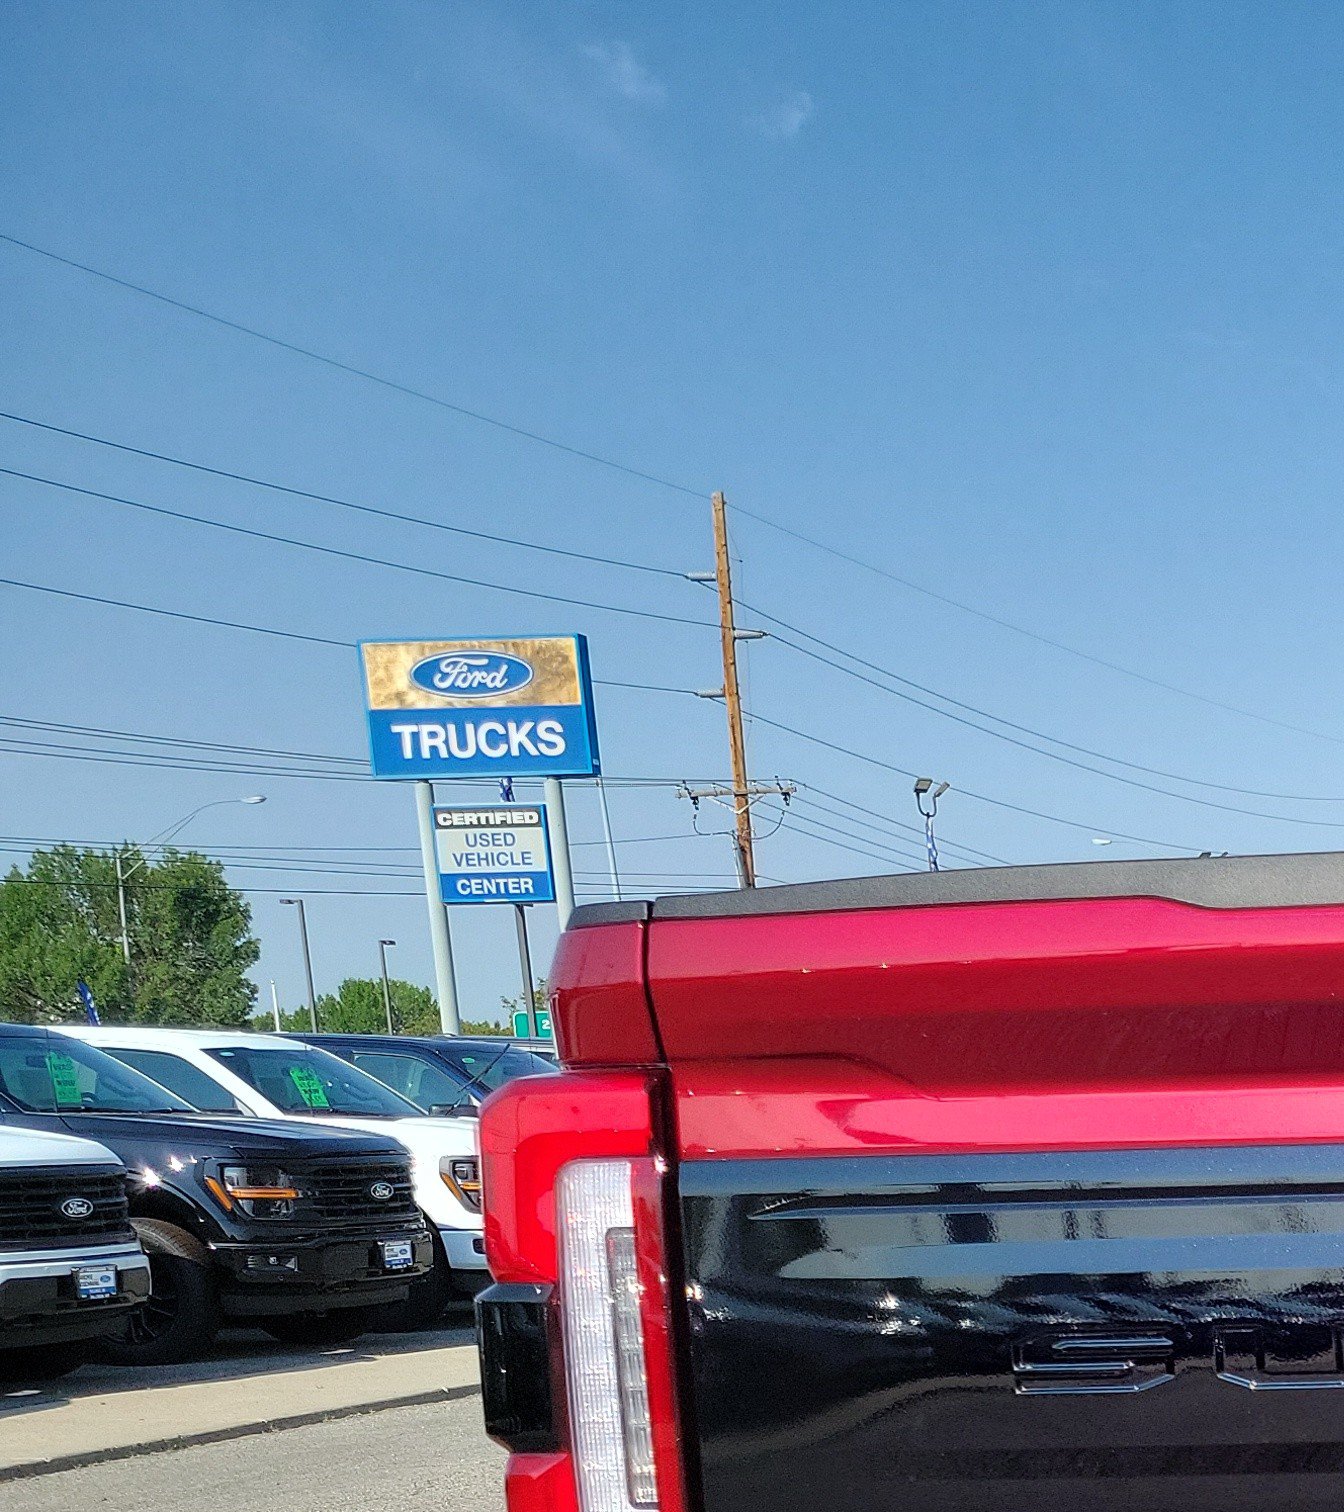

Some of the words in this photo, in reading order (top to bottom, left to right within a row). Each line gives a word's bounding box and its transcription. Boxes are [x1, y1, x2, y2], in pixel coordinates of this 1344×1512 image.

[433, 657, 508, 689] Ford
[391, 720, 566, 759] TRUCKS
[436, 811, 539, 826] CERTIFIED
[465, 833, 516, 848] USED
[452, 851, 533, 867] VEHICLE
[456, 878, 534, 895] CENTER
